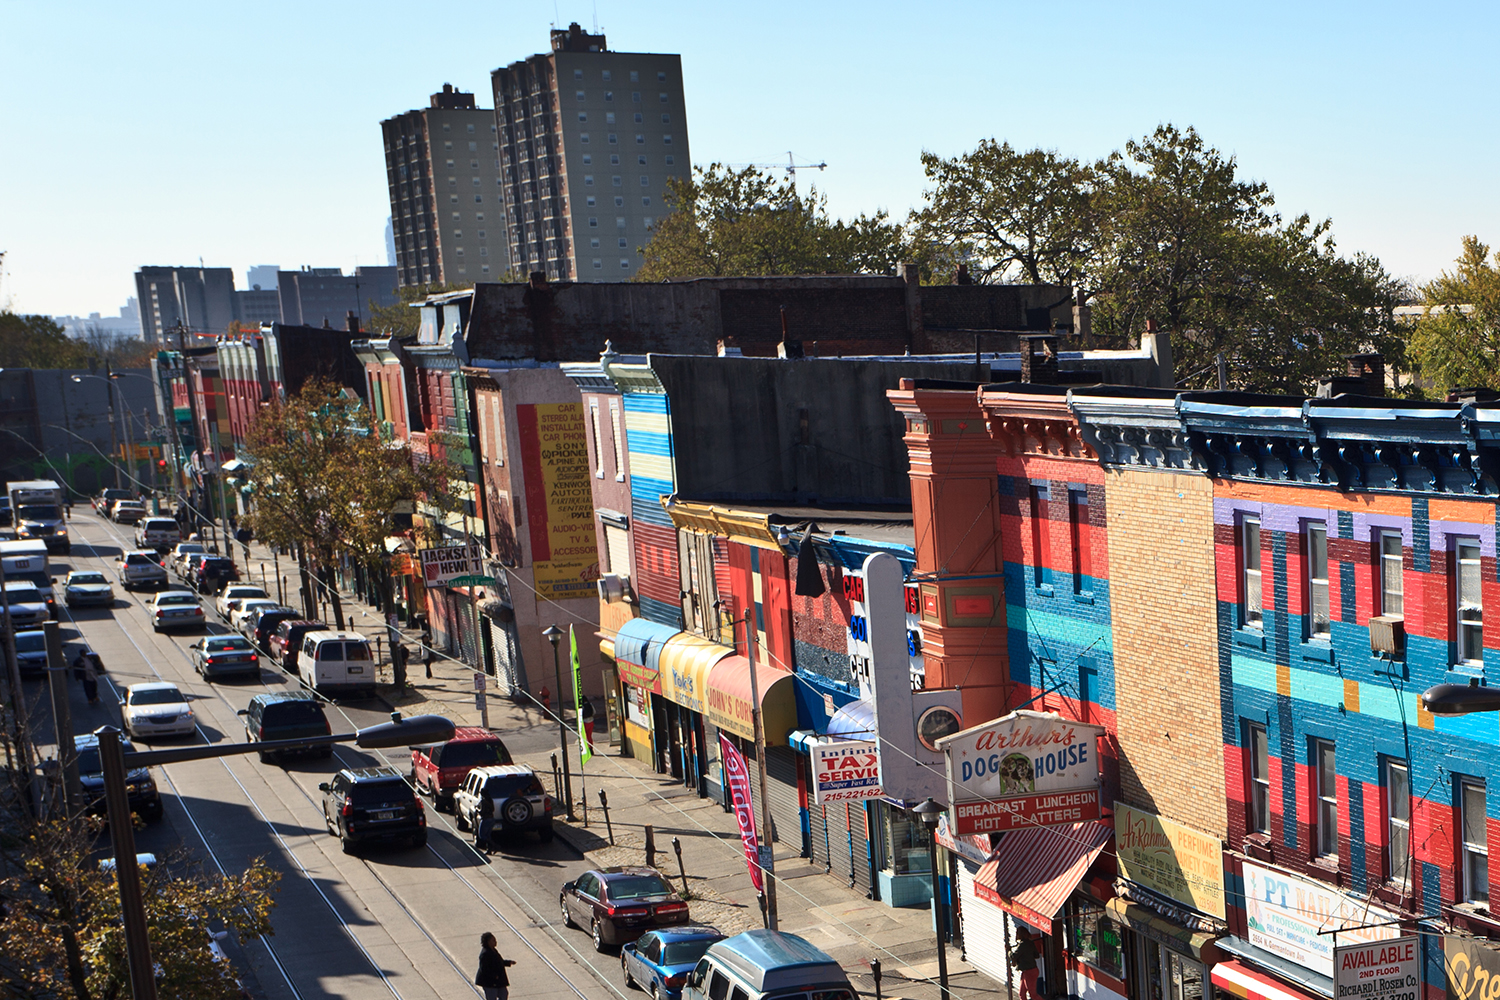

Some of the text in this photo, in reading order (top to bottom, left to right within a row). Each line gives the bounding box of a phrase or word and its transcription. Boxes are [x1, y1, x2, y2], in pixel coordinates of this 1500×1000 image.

[541, 414, 568, 423] STEREO
[557, 404, 576, 413] CAR
[543, 433, 560, 442] CAR
[555, 442, 586, 451] SONY
[547, 458, 575, 466] ALPINE
[569, 535, 590, 544] TV &
[449, 580, 479, 588] OAKDALE
[843, 575, 864, 603] CAR
[675, 691, 704, 712] ELECTRONICS
[708, 688, 733, 716] JOHN'S
[822, 754, 878, 770] TAX
[962, 742, 1088, 782] DOG HOUSE
[958, 792, 1096, 818] BREAKFAST LUNCHEON
[974, 807, 1082, 831] HOT PLATTERS
[1178, 830, 1214, 860] PERFUME
[1175, 849, 1201, 874] VARIETY
[1202, 859, 1219, 881] STORE
[1263, 875, 1395, 941] PT NAIL SALON
[1272, 915, 1318, 938] PROFESSIONAL
[1252, 933, 1263, 945] 2654
[1269, 939, 1296, 959] Germantown
[1296, 951, 1306, 963] Ave.
[1266, 923, 1276, 935] FULL
[1286, 930, 1306, 946] MANICURE
[1309, 939, 1329, 954] PEDICURE
[1342, 944, 1414, 971] AVAILABLE
[1359, 966, 1400, 979] 2ND FLOOR
[1339, 983, 1373, 997] RICHARD
[1379, 978, 1405, 991] ROSEN
[1375, 989, 1397, 997] ESTATE
